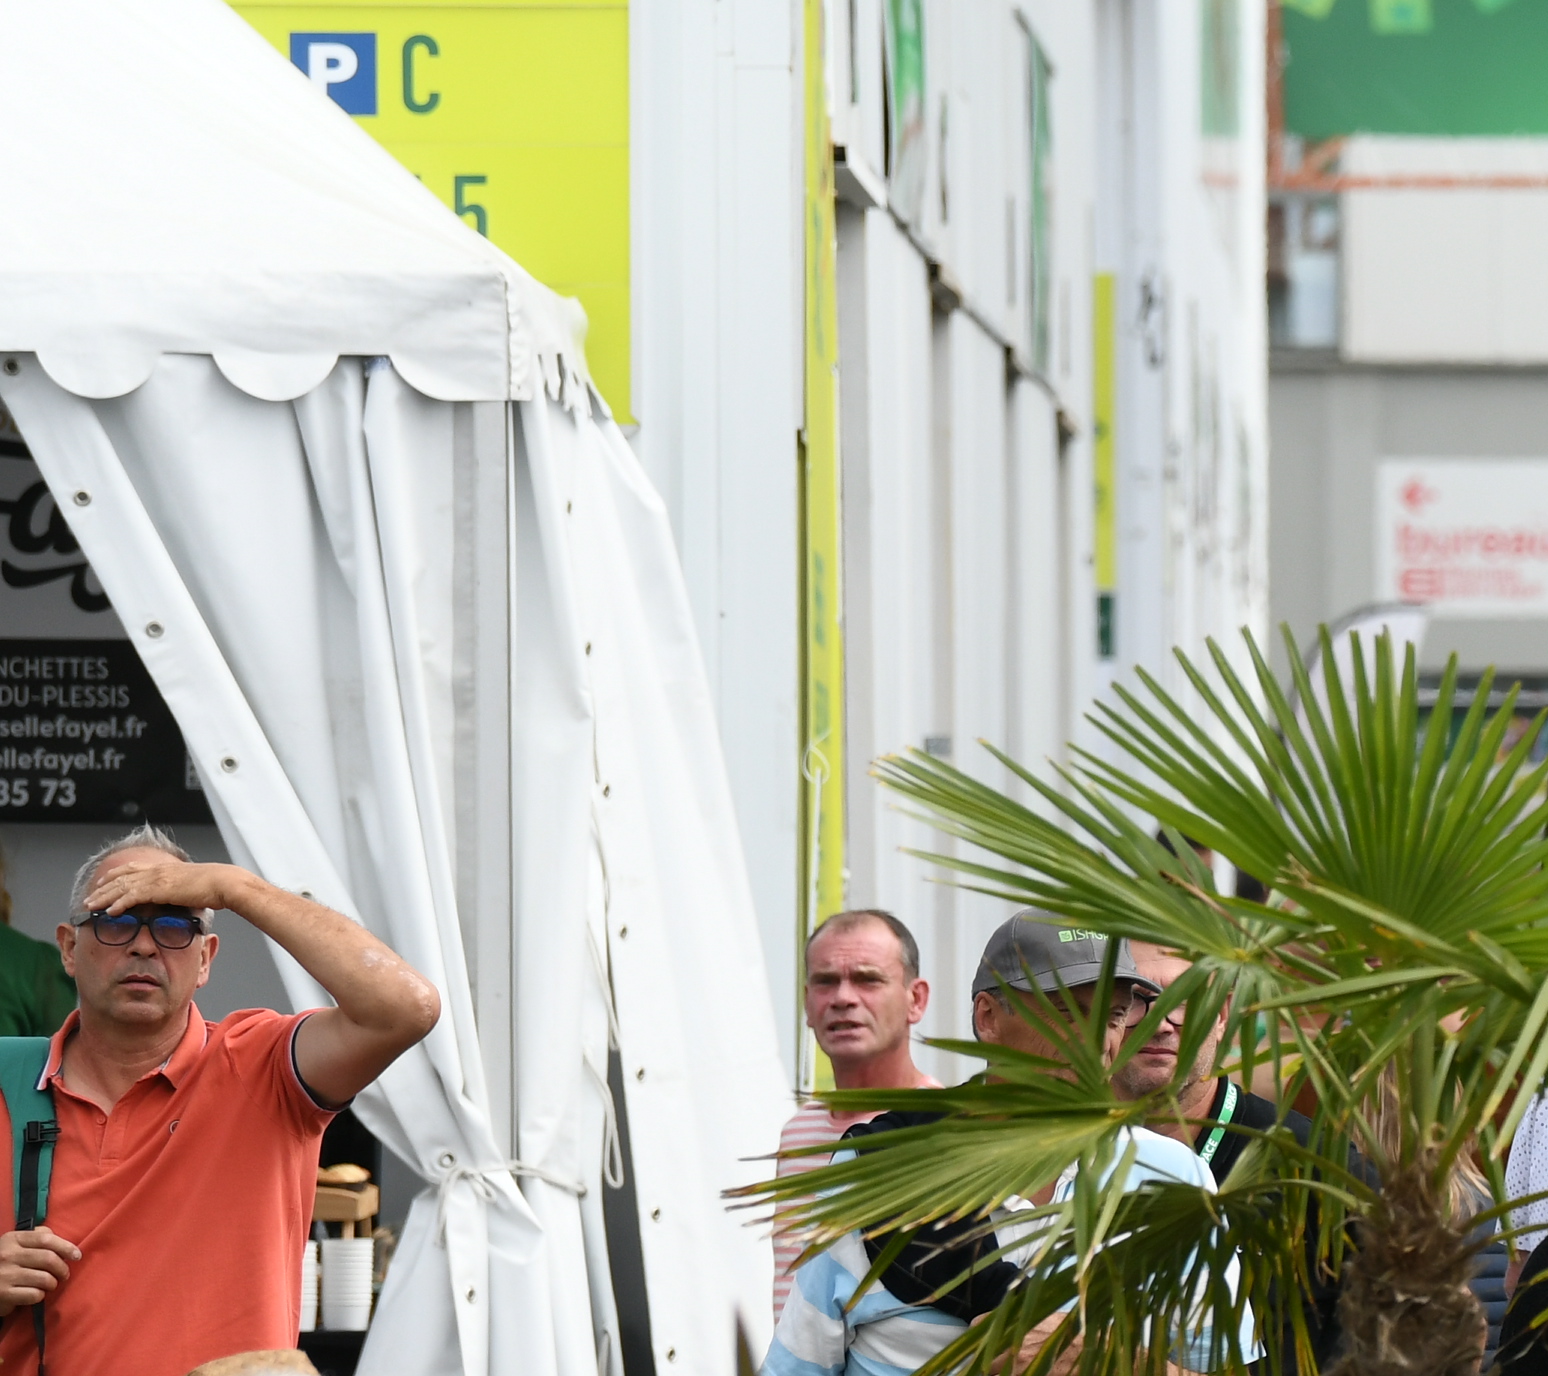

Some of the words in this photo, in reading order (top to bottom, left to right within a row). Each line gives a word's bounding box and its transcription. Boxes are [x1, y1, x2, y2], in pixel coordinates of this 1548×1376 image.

[402, 35, 442, 113] C
[453, 176, 488, 236] 5
[0, 747, 125, 775] llefayel.fr
[40, 778, 76, 807] 73
